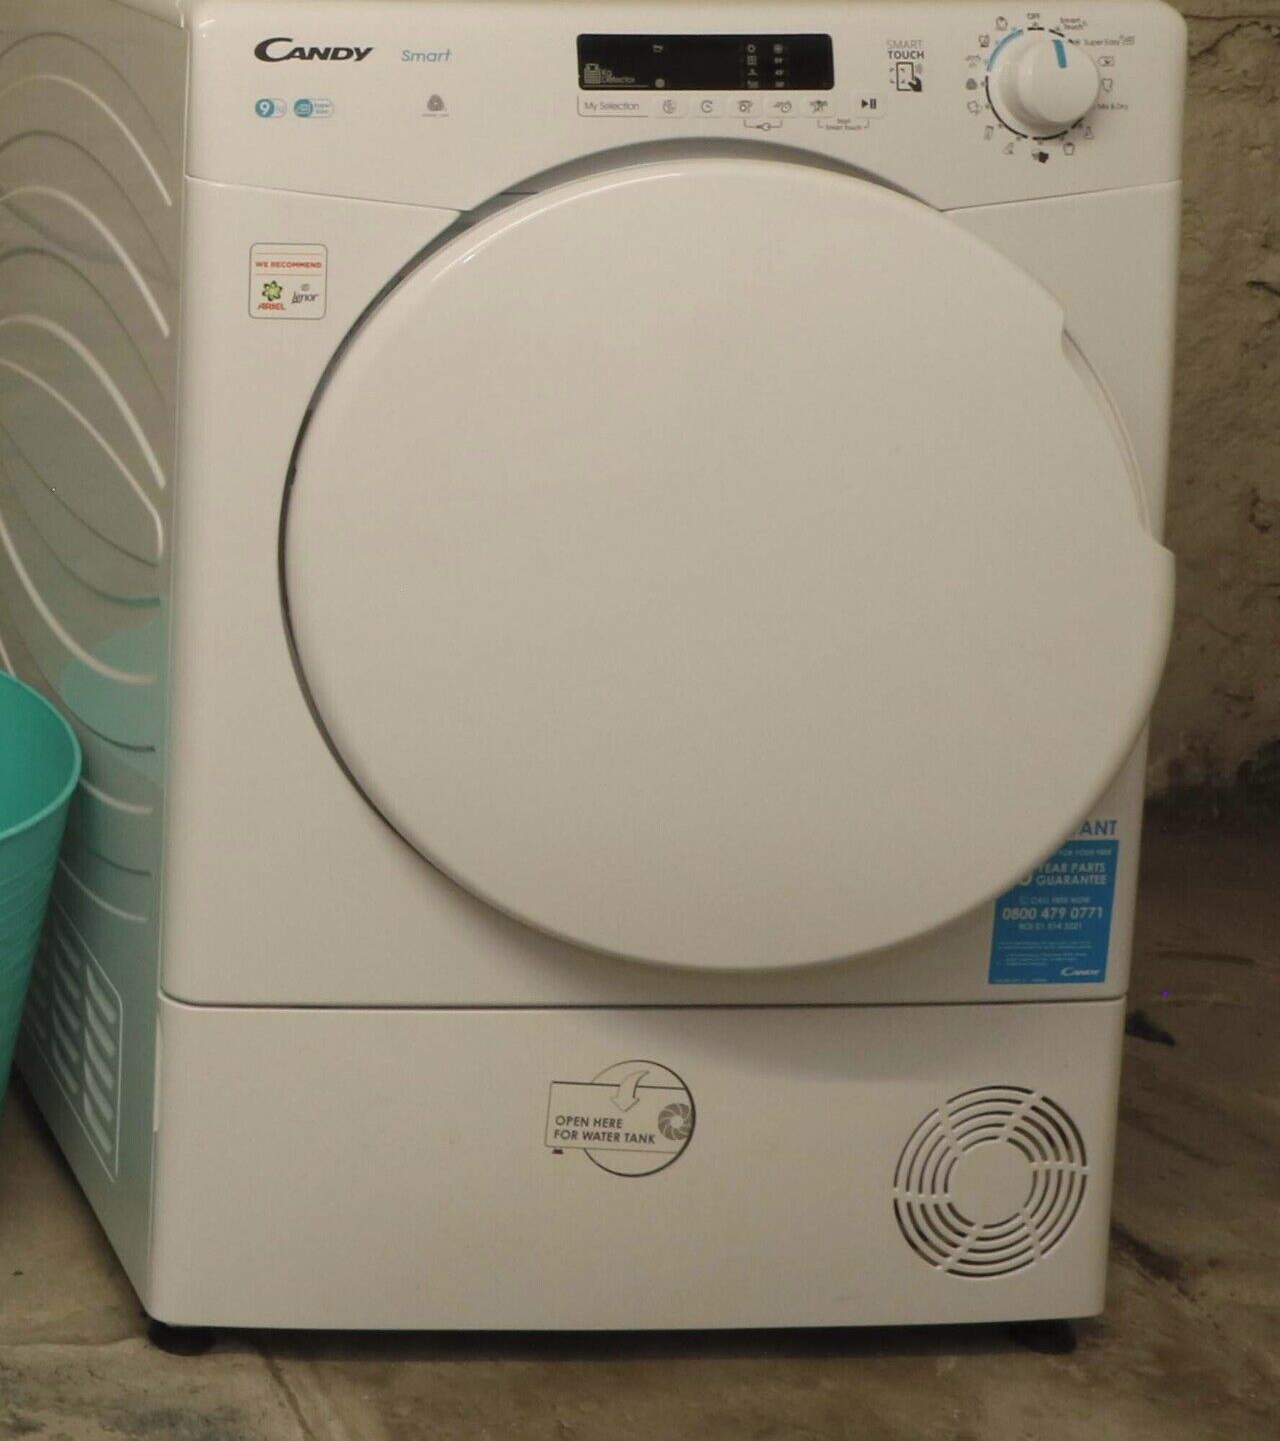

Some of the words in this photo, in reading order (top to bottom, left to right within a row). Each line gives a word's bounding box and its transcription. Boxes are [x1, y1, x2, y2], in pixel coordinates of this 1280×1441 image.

[886, 40, 922, 50] SMART
[401, 48, 452, 62] Smart
[887, 51, 925, 59] TOUCH
[260, 101, 270, 115] 9
[1071, 862, 1105, 873] PARTS
[1036, 874, 1107, 885] GUARANTEE
[1002, 907, 1037, 920] 0800
[1040, 907, 1066, 920] 479
[1070, 907, 1103, 919] 0771
[555, 1115, 589, 1127] OPEN
[593, 1117, 623, 1129] HERE
[554, 1129, 577, 1140] FOR
[582, 1131, 620, 1143] WATER
[625, 1132, 656, 1145] TANK
